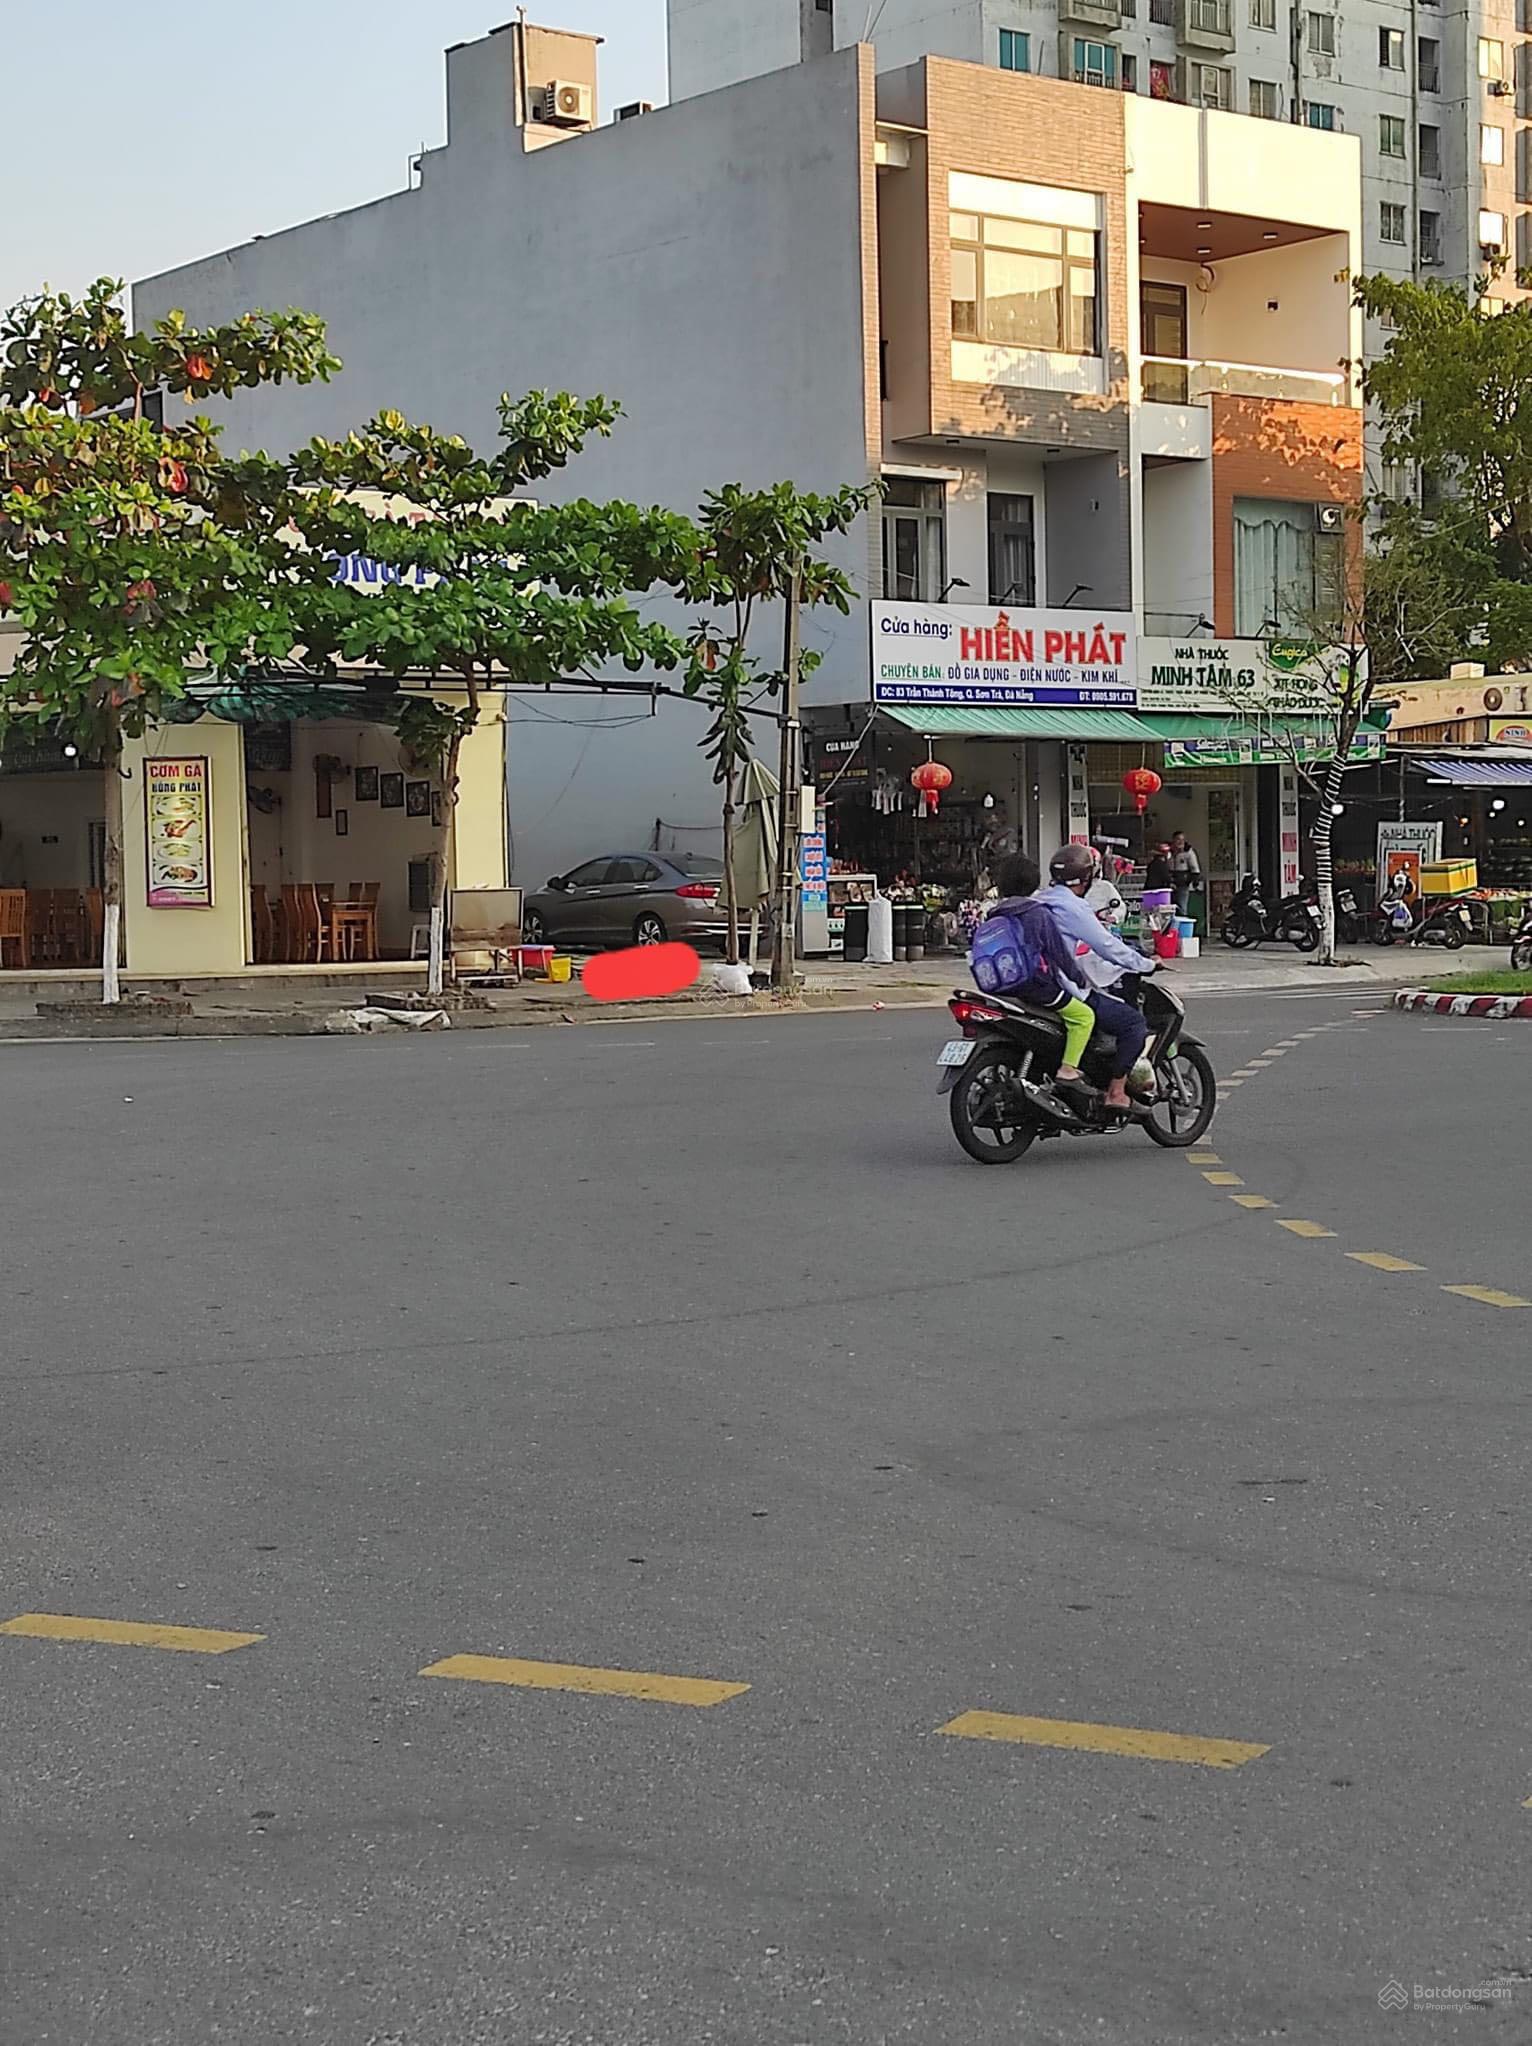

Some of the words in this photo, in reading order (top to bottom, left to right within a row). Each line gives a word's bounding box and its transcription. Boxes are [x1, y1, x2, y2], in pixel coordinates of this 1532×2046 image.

[881, 616, 909, 633] Cửa
[914, 618, 953, 640] hàng:
[960, 610, 1034, 662] HIỀN
[1272, 643, 1308, 660] Eugica
[881, 663, 919, 678] CHUYÊN
[948, 662, 961, 679] ĐỒ
[964, 666, 980, 680] GIA
[983, 667, 1010, 683] DỤNG
[1020, 667, 1042, 683] ĐIỆN
[1045, 668, 1071, 683] NƯỚC
[1081, 670, 1099, 683] KIM
[1151, 666, 1193, 686] MINH
[1196, 663, 1233, 687] TÂM
[1237, 669, 1255, 687] 63
